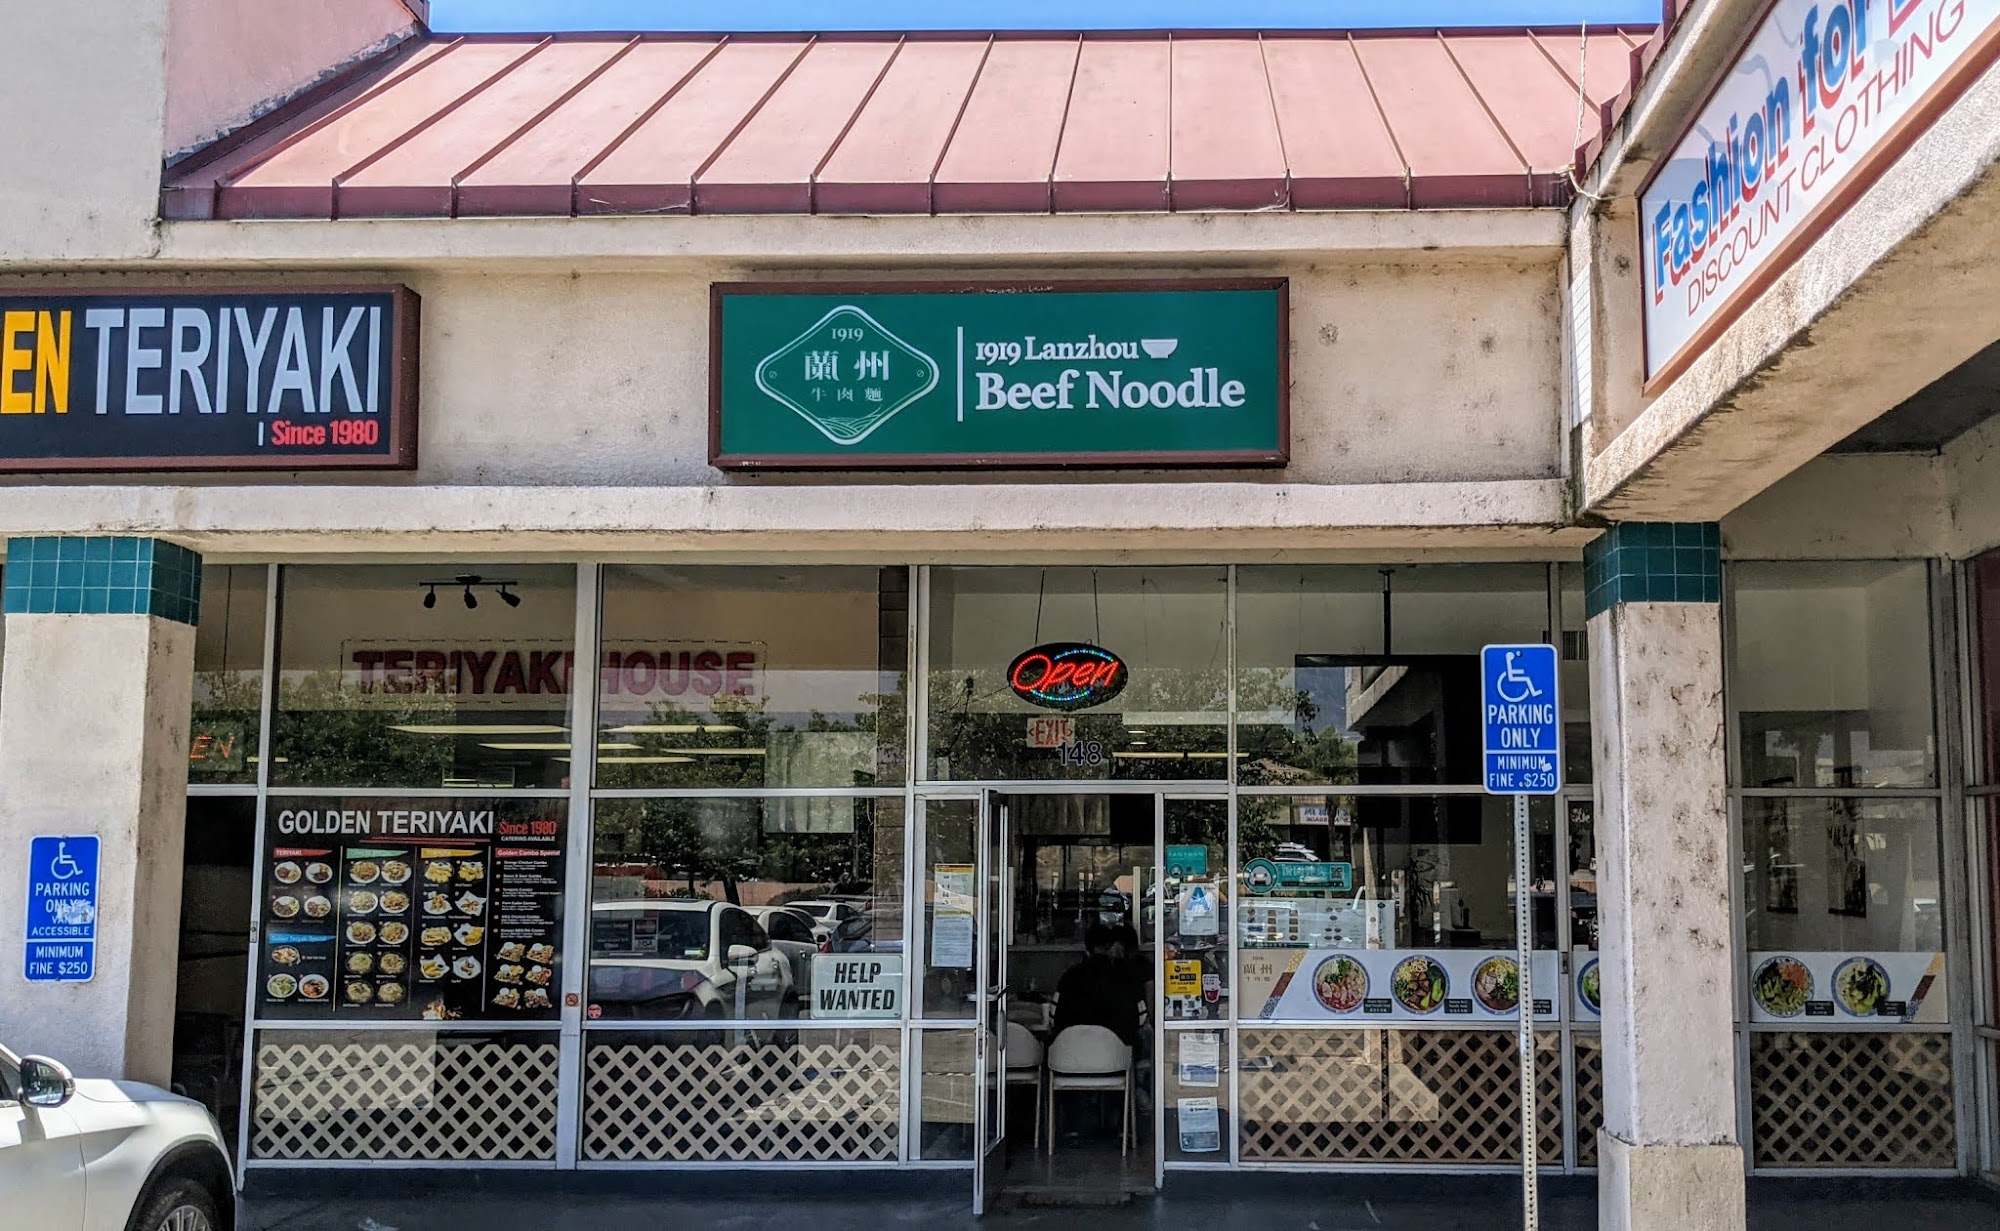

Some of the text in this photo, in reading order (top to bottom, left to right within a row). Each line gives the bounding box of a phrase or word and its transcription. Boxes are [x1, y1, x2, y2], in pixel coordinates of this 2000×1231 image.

[1687, 0, 1964, 317] DISCOUNT CLOTHING
[1652, 76, 1790, 305] Fashion
[832, 328, 864, 342] 1919
[0, 306, 382, 415] EN TERIYAKI
[975, 334, 1139, 366] 1919 Lanzhou
[975, 367, 1246, 410] Beef Noodle
[271, 419, 379, 446] Since 1980
[352, 650, 574, 695] TERIYAKI
[1012, 653, 1119, 693] Open
[1488, 704, 1553, 725] PARKING
[1035, 719, 1069, 746] EXIT
[1501, 727, 1541, 748] ONLY
[1057, 741, 1102, 767] 148
[1497, 755, 1546, 771] MINIMUM
[1489, 773, 1514, 788] FINE
[278, 809, 495, 835] GOLDEN TERIYAKI
[499, 820, 557, 835] Since 1980
[35, 882, 90, 897] PARKING
[31, 926, 90, 936] ACCESSIBLE
[36, 946, 84, 958] MINIMUM
[30, 961, 88, 976] FINE $250
[834, 962, 882, 984] HELP
[820, 989, 895, 1011] WANTED
